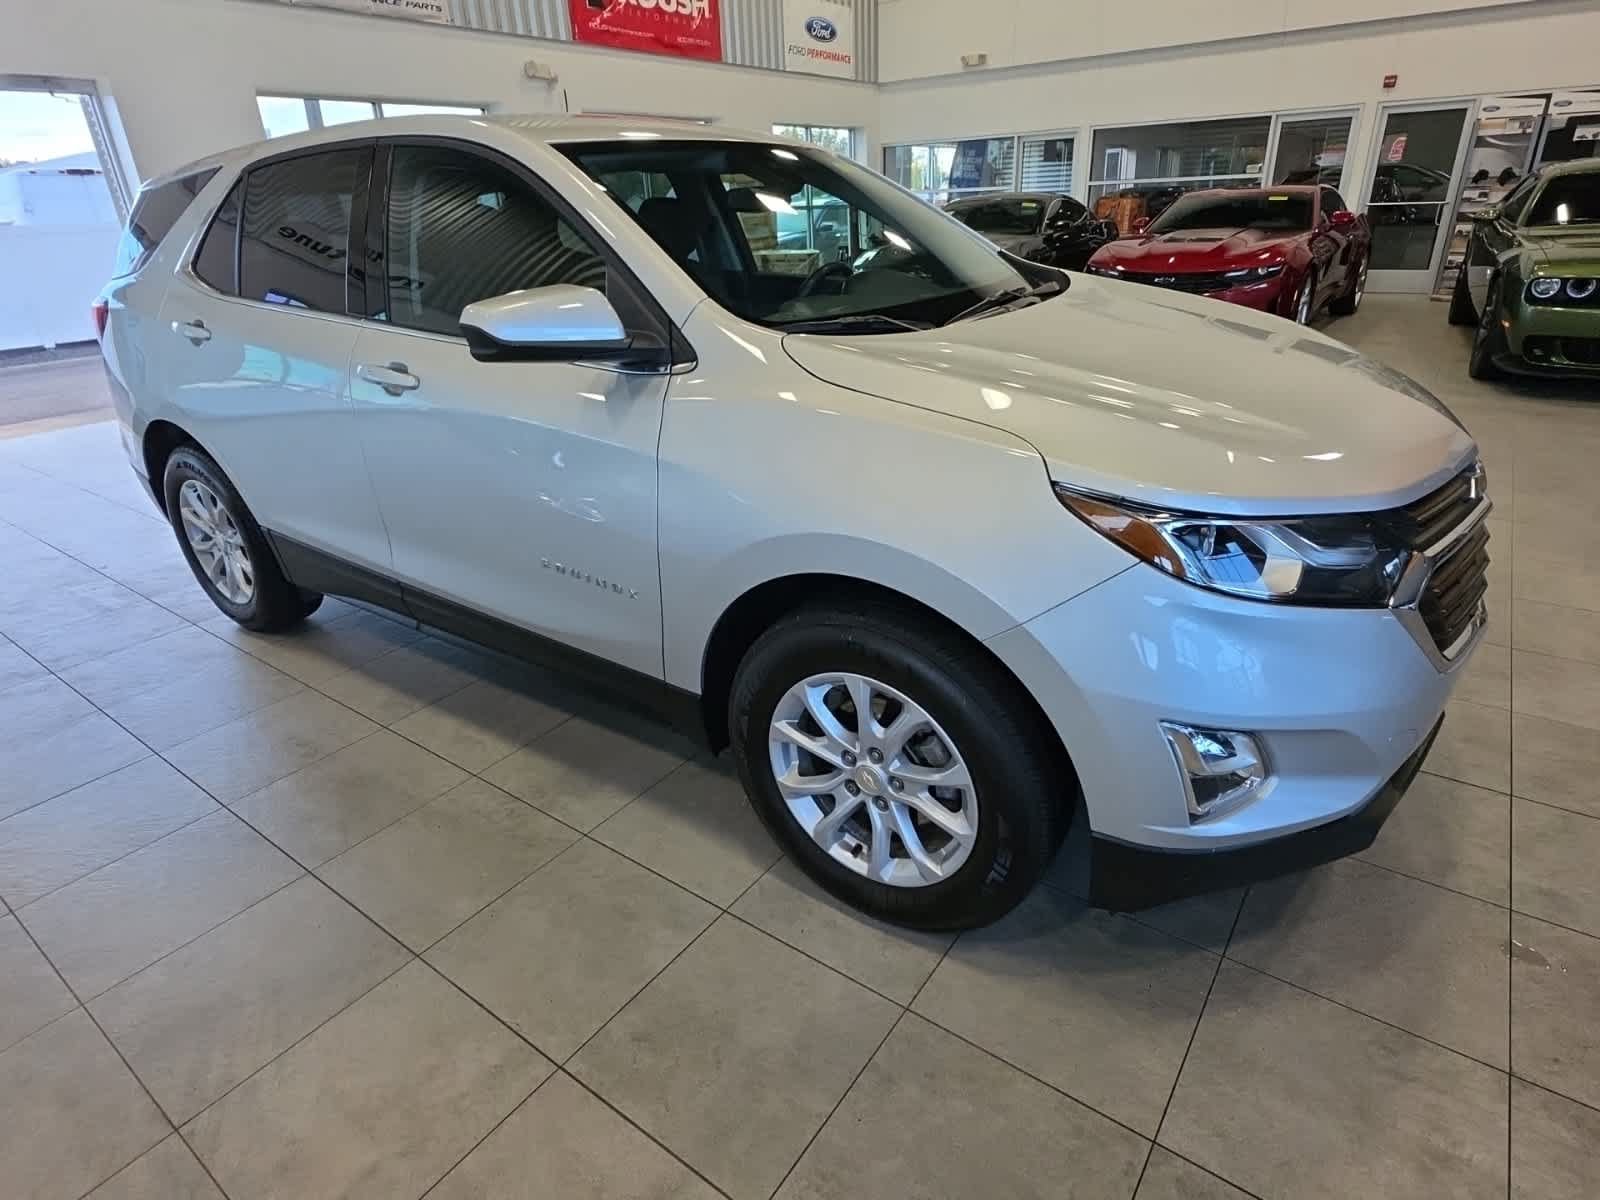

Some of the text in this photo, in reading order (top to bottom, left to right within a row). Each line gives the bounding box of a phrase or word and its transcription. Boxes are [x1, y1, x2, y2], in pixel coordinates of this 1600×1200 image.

[405, 1, 442, 12] PARTS
[811, 20, 832, 39] Ford
[788, 44, 852, 64] FORD PERFORMANCE
